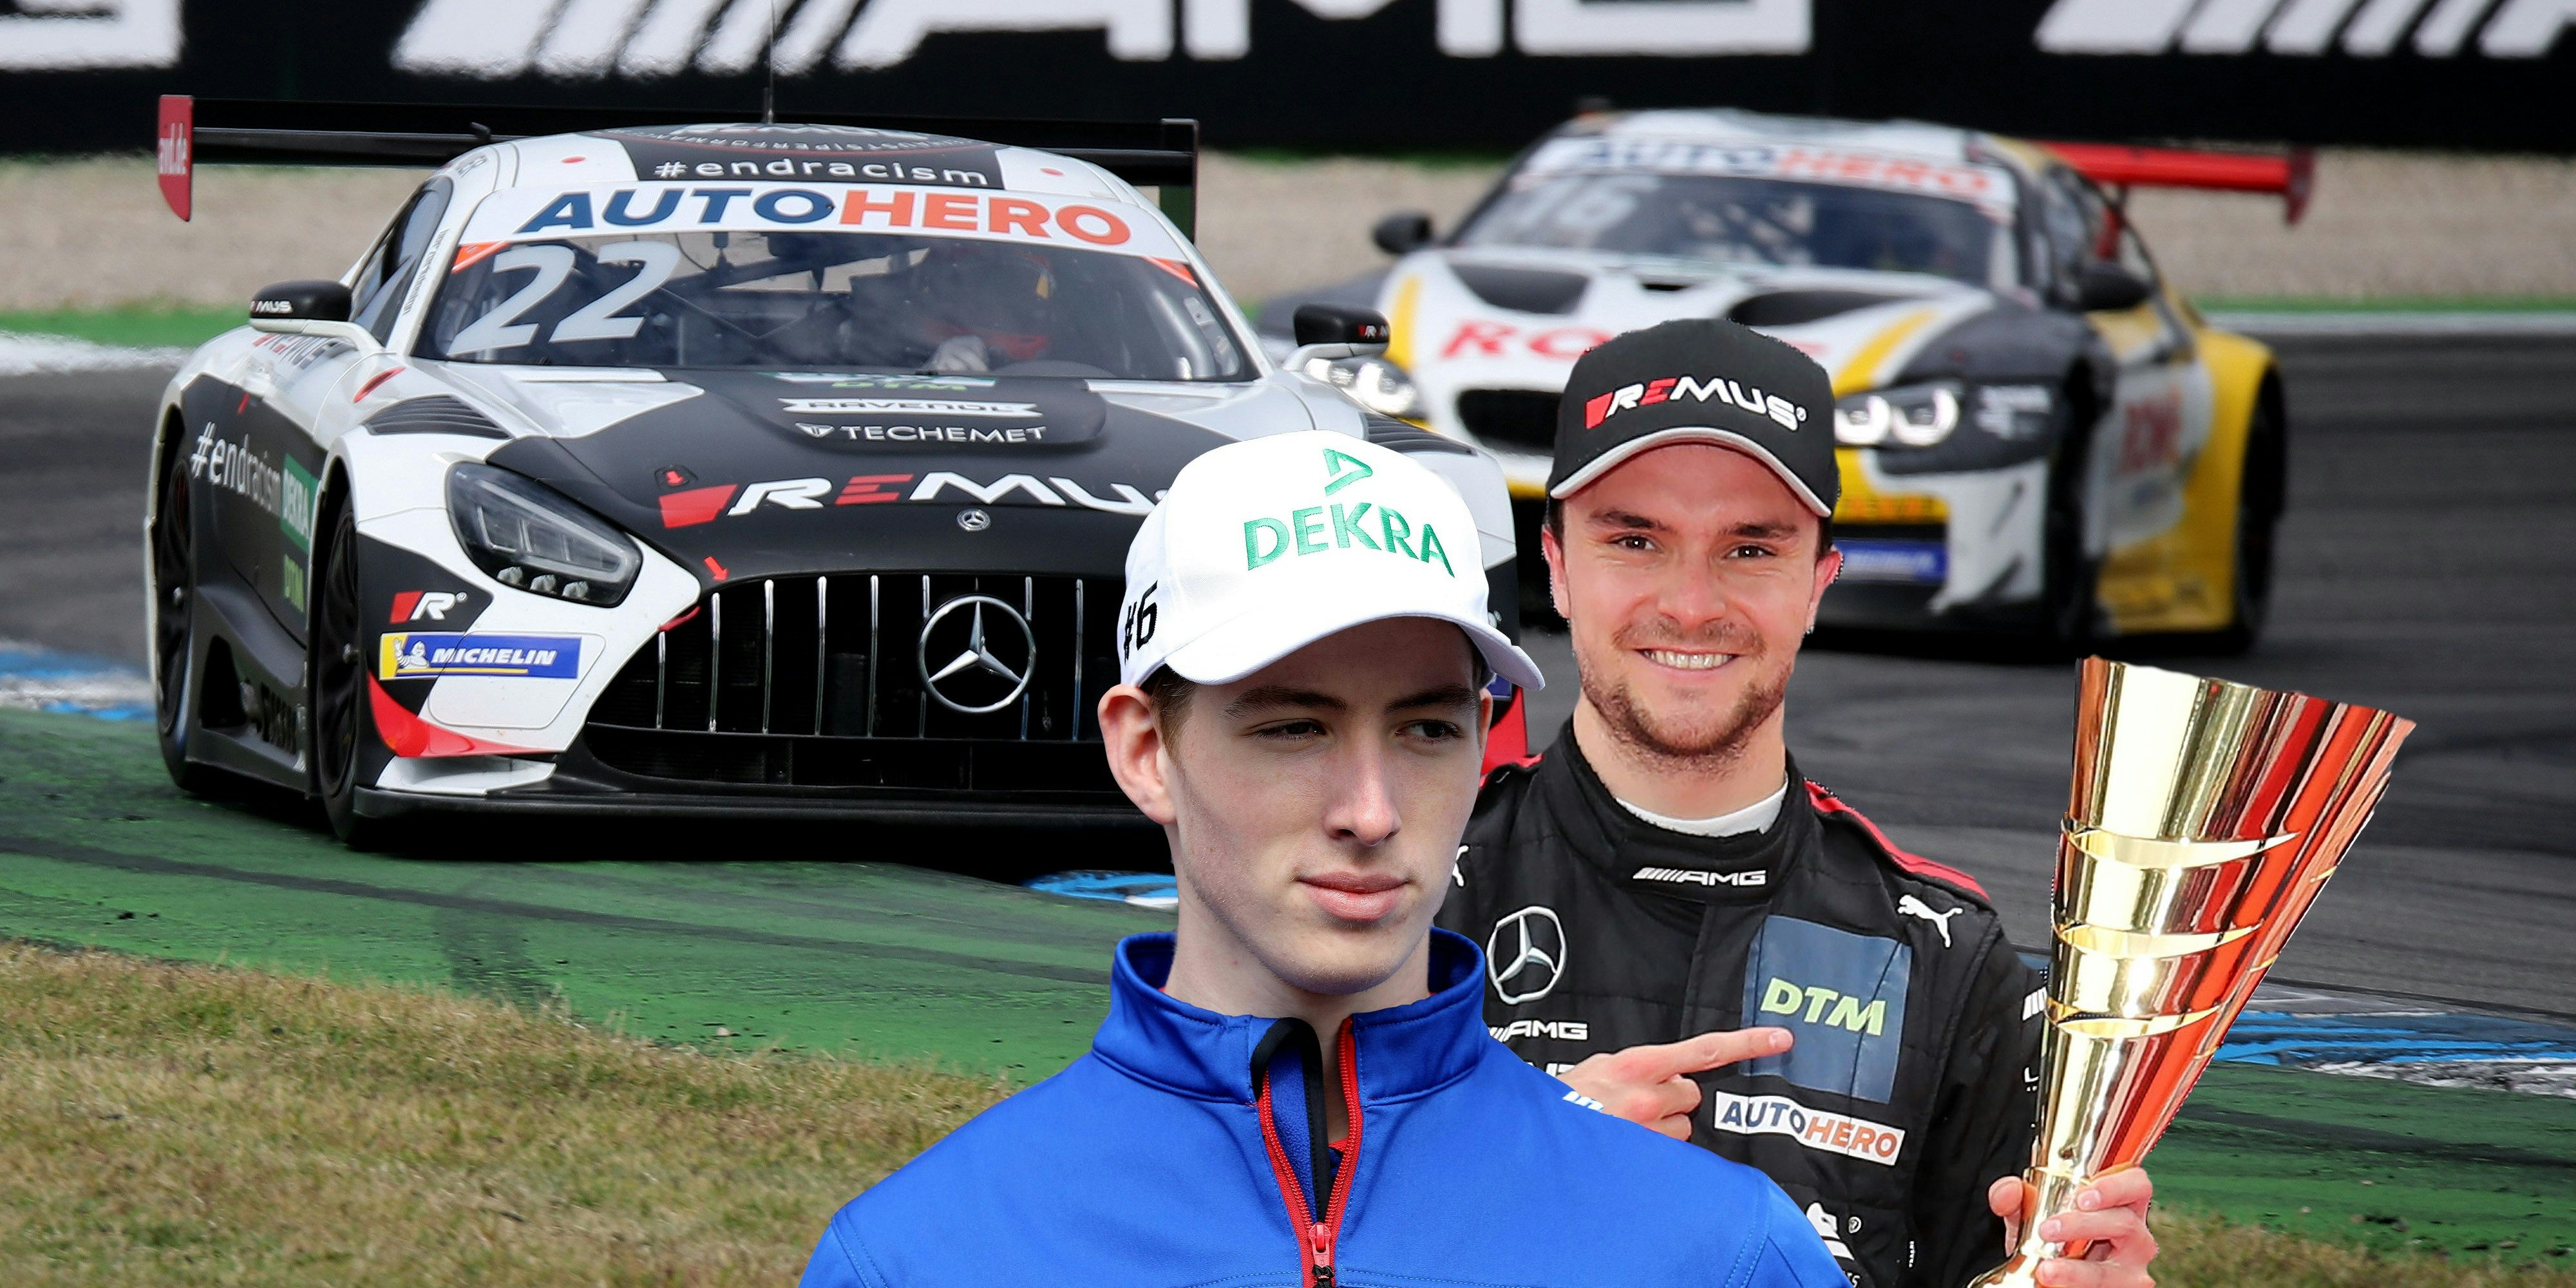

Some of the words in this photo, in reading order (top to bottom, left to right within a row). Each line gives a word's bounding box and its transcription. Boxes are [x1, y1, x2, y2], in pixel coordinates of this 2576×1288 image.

[654, 158, 989, 185] #endracism
[514, 189, 1131, 245] AUTOHERO
[447, 241, 680, 357] 22
[840, 426, 1046, 443] TECHEMET
[728, 471, 1167, 515] REMU
[1244, 502, 1455, 578] DEKRA
[1123, 579, 1158, 666] #6
[431, 648, 558, 665] MICHELIN
[1759, 977, 1886, 1036] DTM
[1721, 1100, 1899, 1160] AUTOHERO
